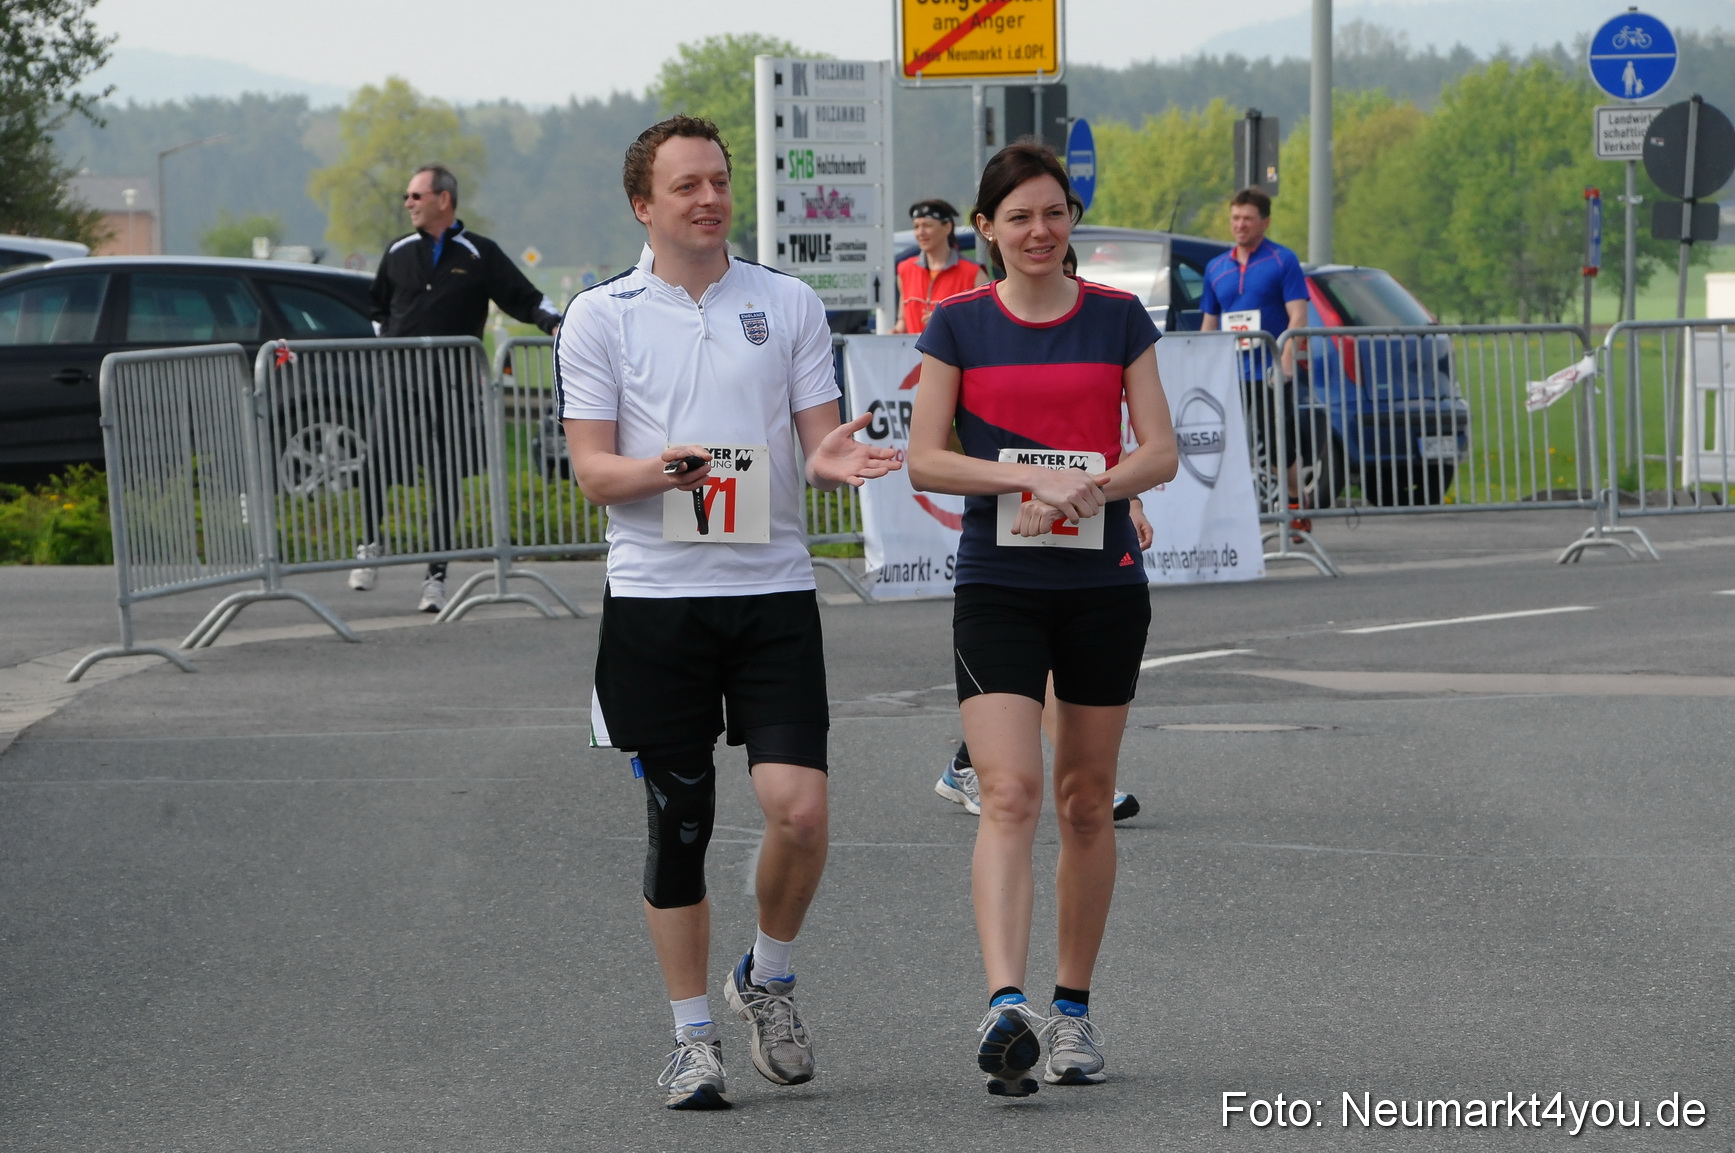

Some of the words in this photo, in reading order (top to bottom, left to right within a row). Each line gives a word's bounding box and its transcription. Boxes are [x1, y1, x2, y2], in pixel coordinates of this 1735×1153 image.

[932, 16, 961, 31] am
[970, 12, 1025, 34] Anger
[947, 47, 1003, 62] Neumarkt
[1603, 125, 1648, 139] schaftlic
[1603, 140, 1641, 152] Verkehr
[788, 149, 815, 180] SHB
[816, 153, 867, 175] Holzfachmarkt
[788, 233, 833, 263] THULE
[866, 399, 914, 440] GER
[1016, 453, 1066, 466] MEYER
[944, 554, 955, 580] S
